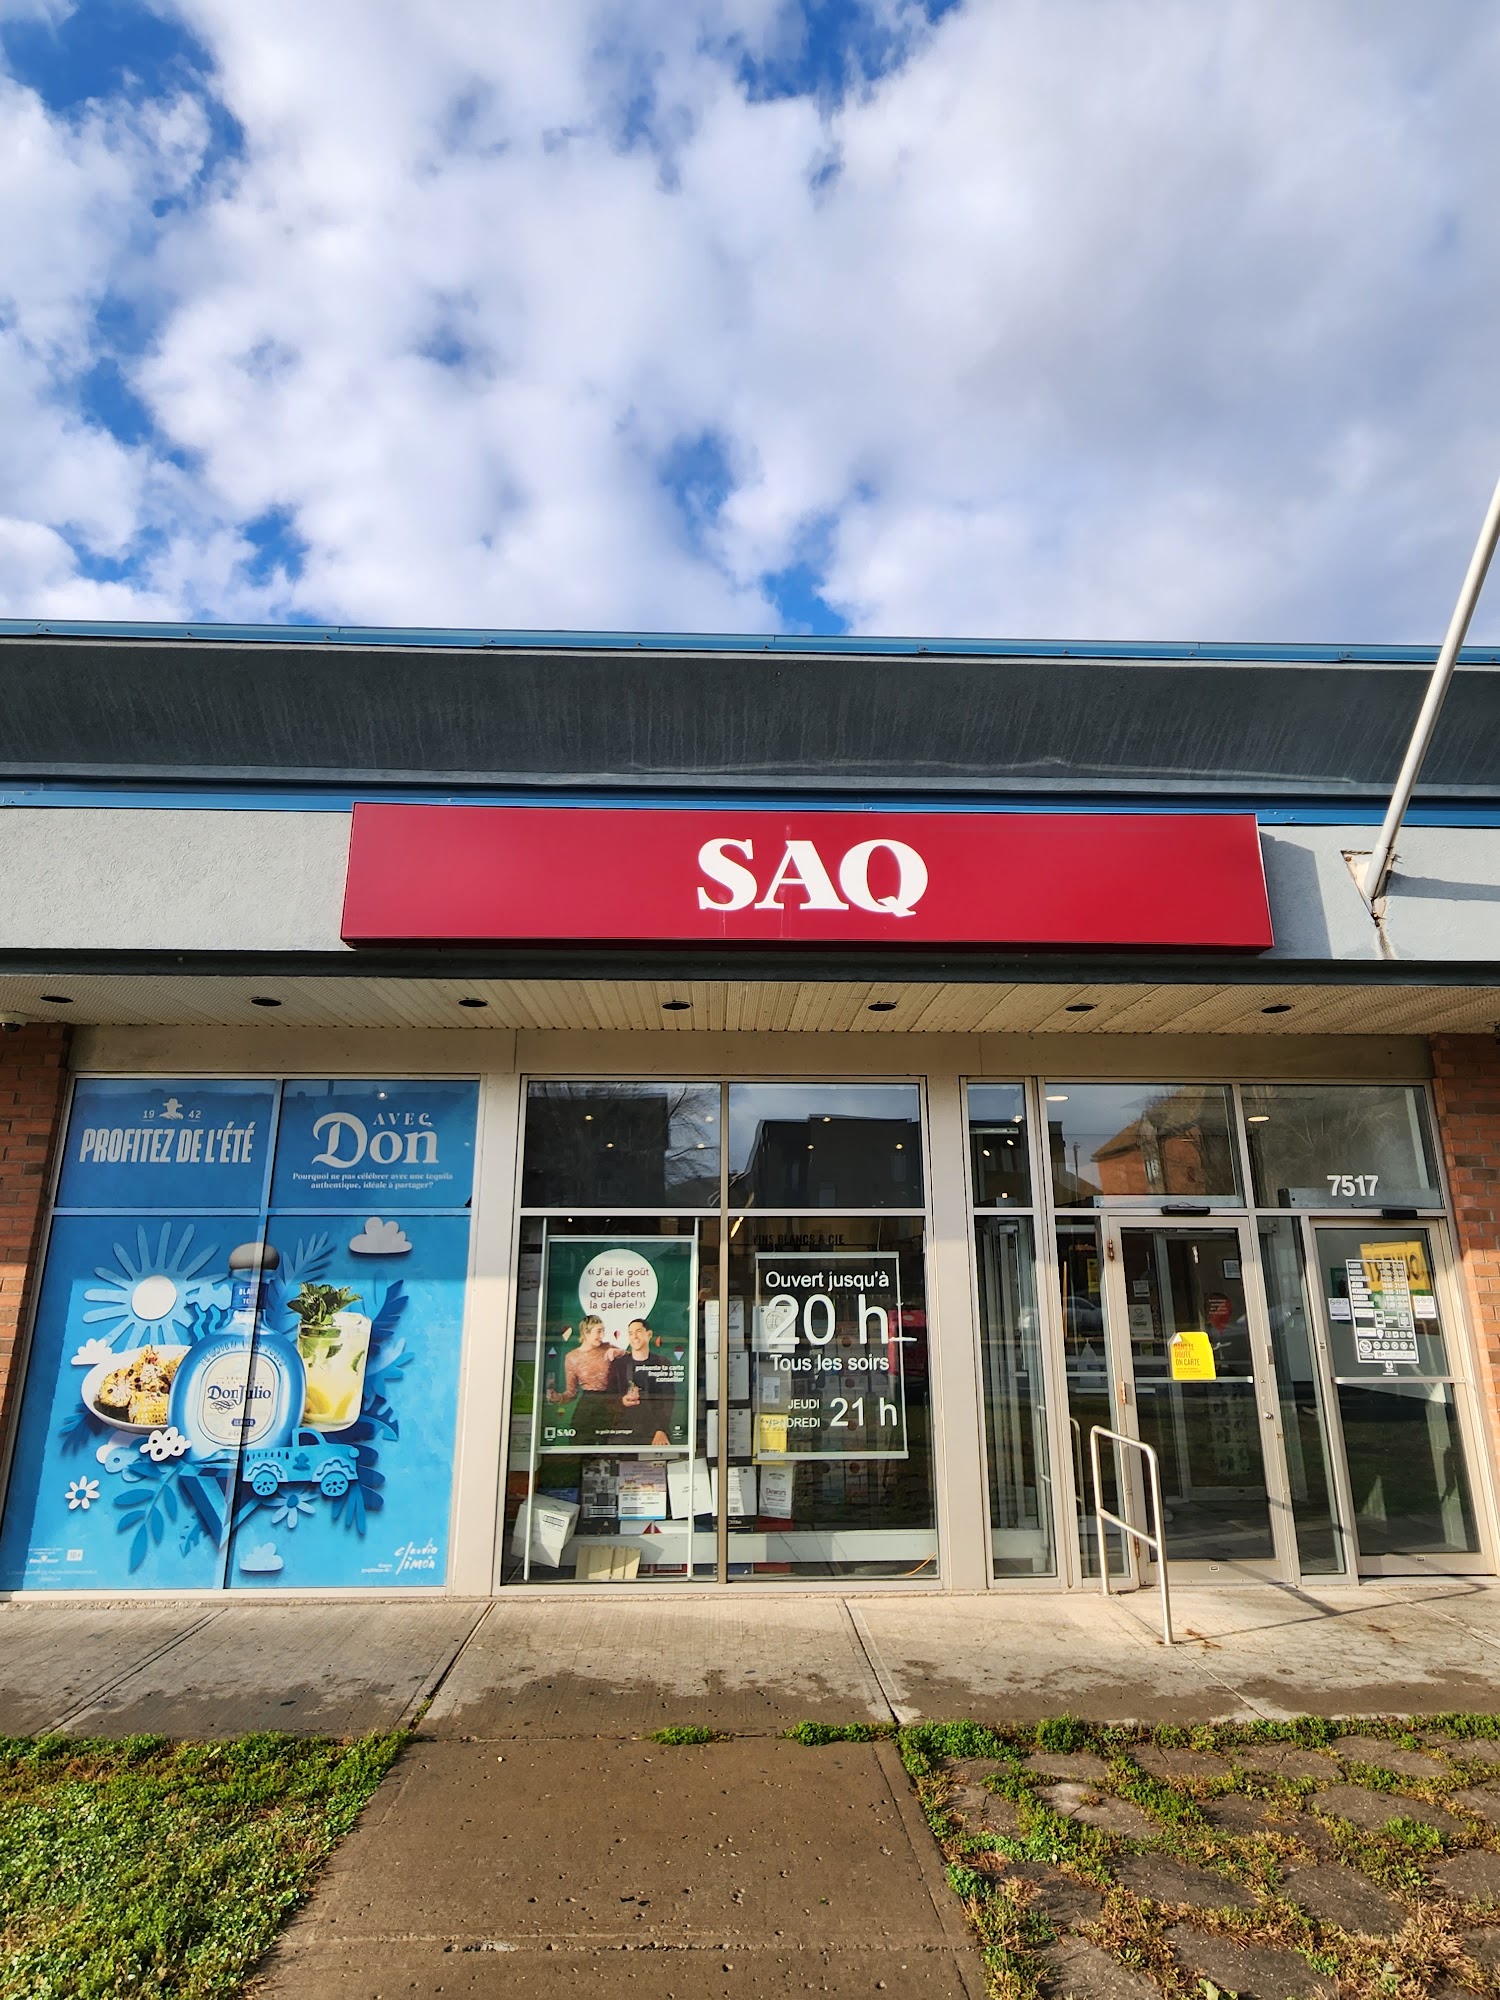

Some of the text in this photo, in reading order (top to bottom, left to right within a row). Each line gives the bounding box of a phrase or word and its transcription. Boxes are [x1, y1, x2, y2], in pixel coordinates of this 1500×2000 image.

[697, 838, 929, 917] SAQ
[142, 1109, 202, 1119] 19 42
[372, 1112, 431, 1127] AVEC
[79, 1121, 256, 1163] PROFITEZ DE L'ÉTÉ
[311, 1111, 440, 1169] Don
[292, 1172, 329, 1182] Pourquoi
[341, 1173, 356, 1182] pas
[357, 1172, 389, 1180] célébrer
[426, 1172, 453, 1181] tequila
[310, 1181, 434, 1190] authentique, idéale à partager?
[1326, 1174, 1379, 1197] 7517
[777, 1234, 815, 1245] BLANCS
[828, 1234, 845, 1245] CIE
[615, 1267, 624, 1276] le
[627, 1267, 650, 1278] goût
[596, 1279, 641, 1287] de bulles
[765, 1270, 890, 1292] Ouvert jusqu'à
[589, 1289, 647, 1299] qui épatent
[589, 1300, 598, 1309] la
[767, 1293, 890, 1346] 20 h
[770, 1353, 890, 1371] Tous les soirs
[1175, 1358, 1200, 1366] ON CARTE
[787, 1396, 898, 1427] JEUDI 21 h
[556, 1428, 577, 1437] SAQ
